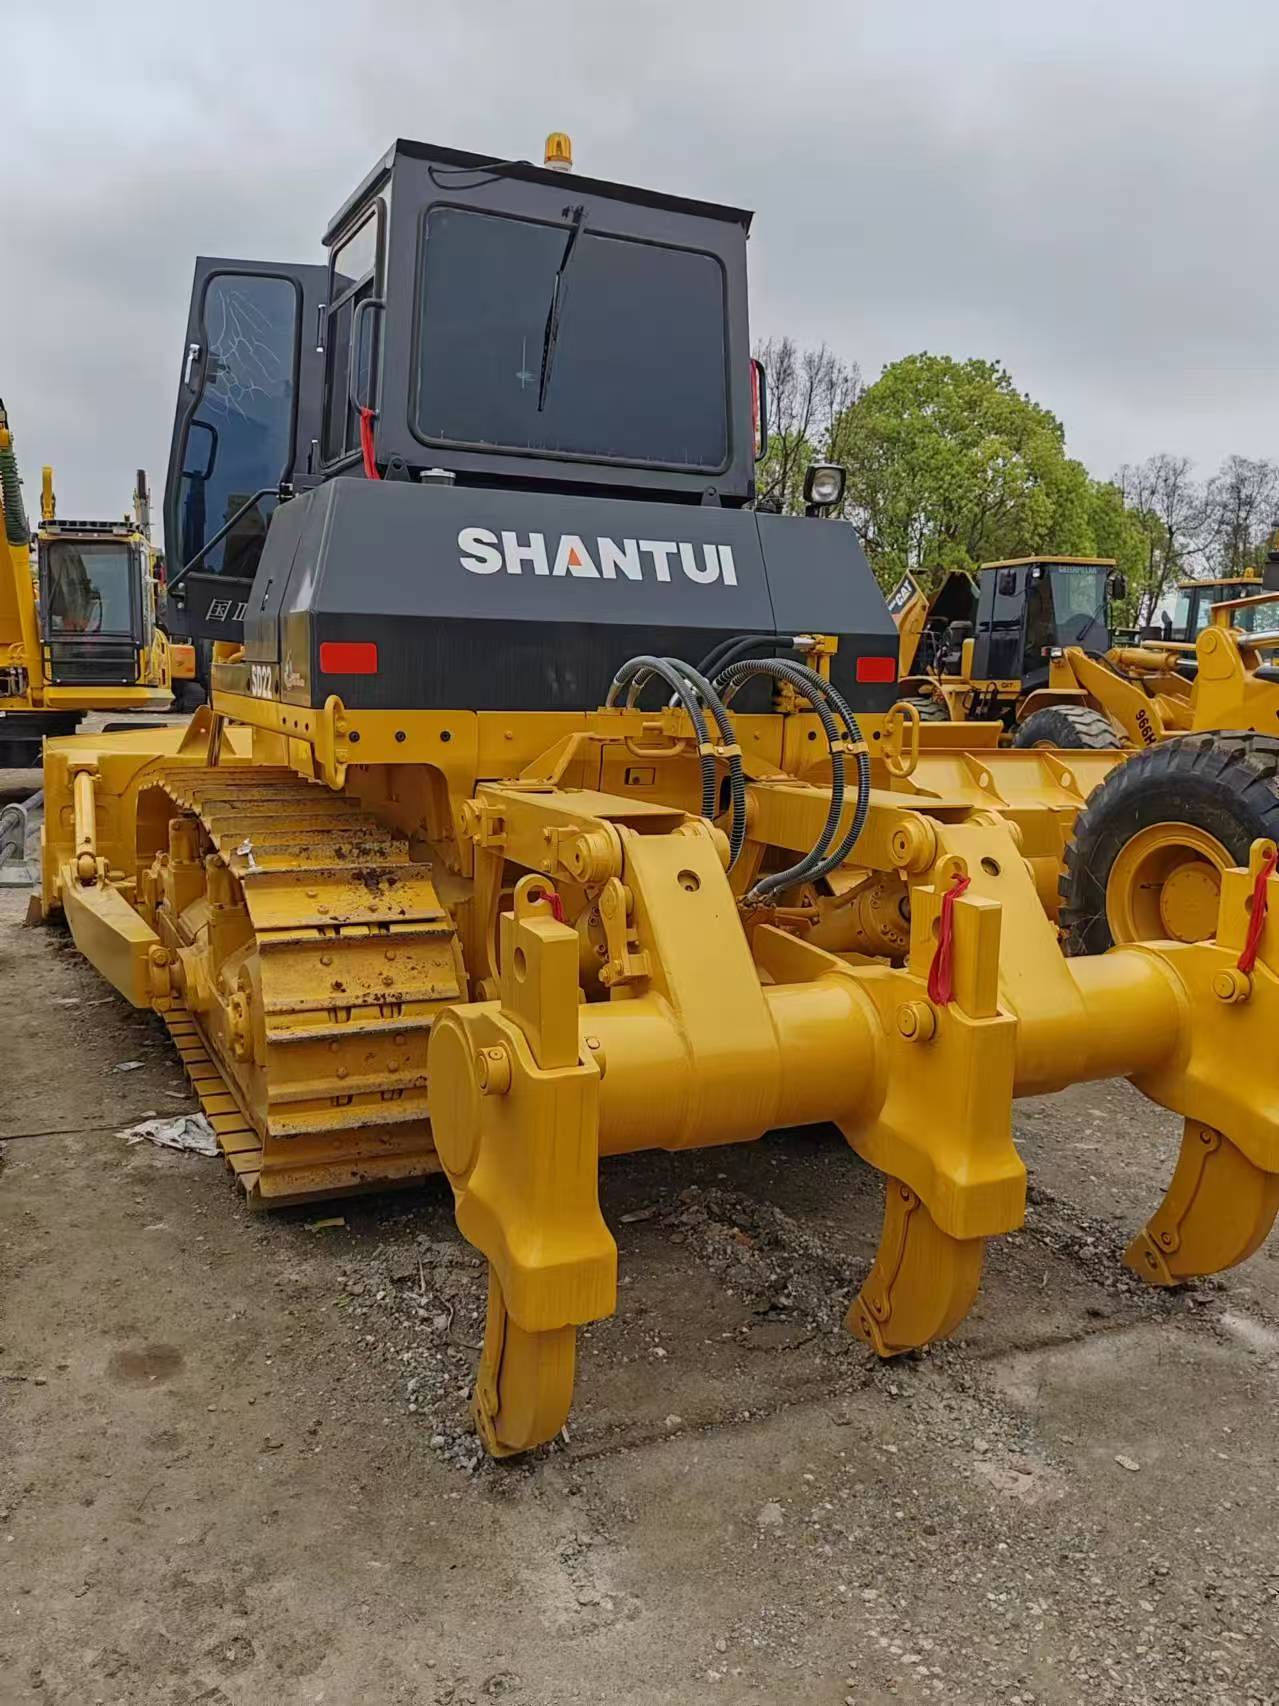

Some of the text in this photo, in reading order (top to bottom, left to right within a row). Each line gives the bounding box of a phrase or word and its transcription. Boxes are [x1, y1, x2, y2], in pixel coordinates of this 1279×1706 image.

[457, 527, 738, 586] SHANTUI
[895, 579, 912, 606] CAT
[251, 664, 273, 701] SD22
[1135, 709, 1157, 746] 966H
